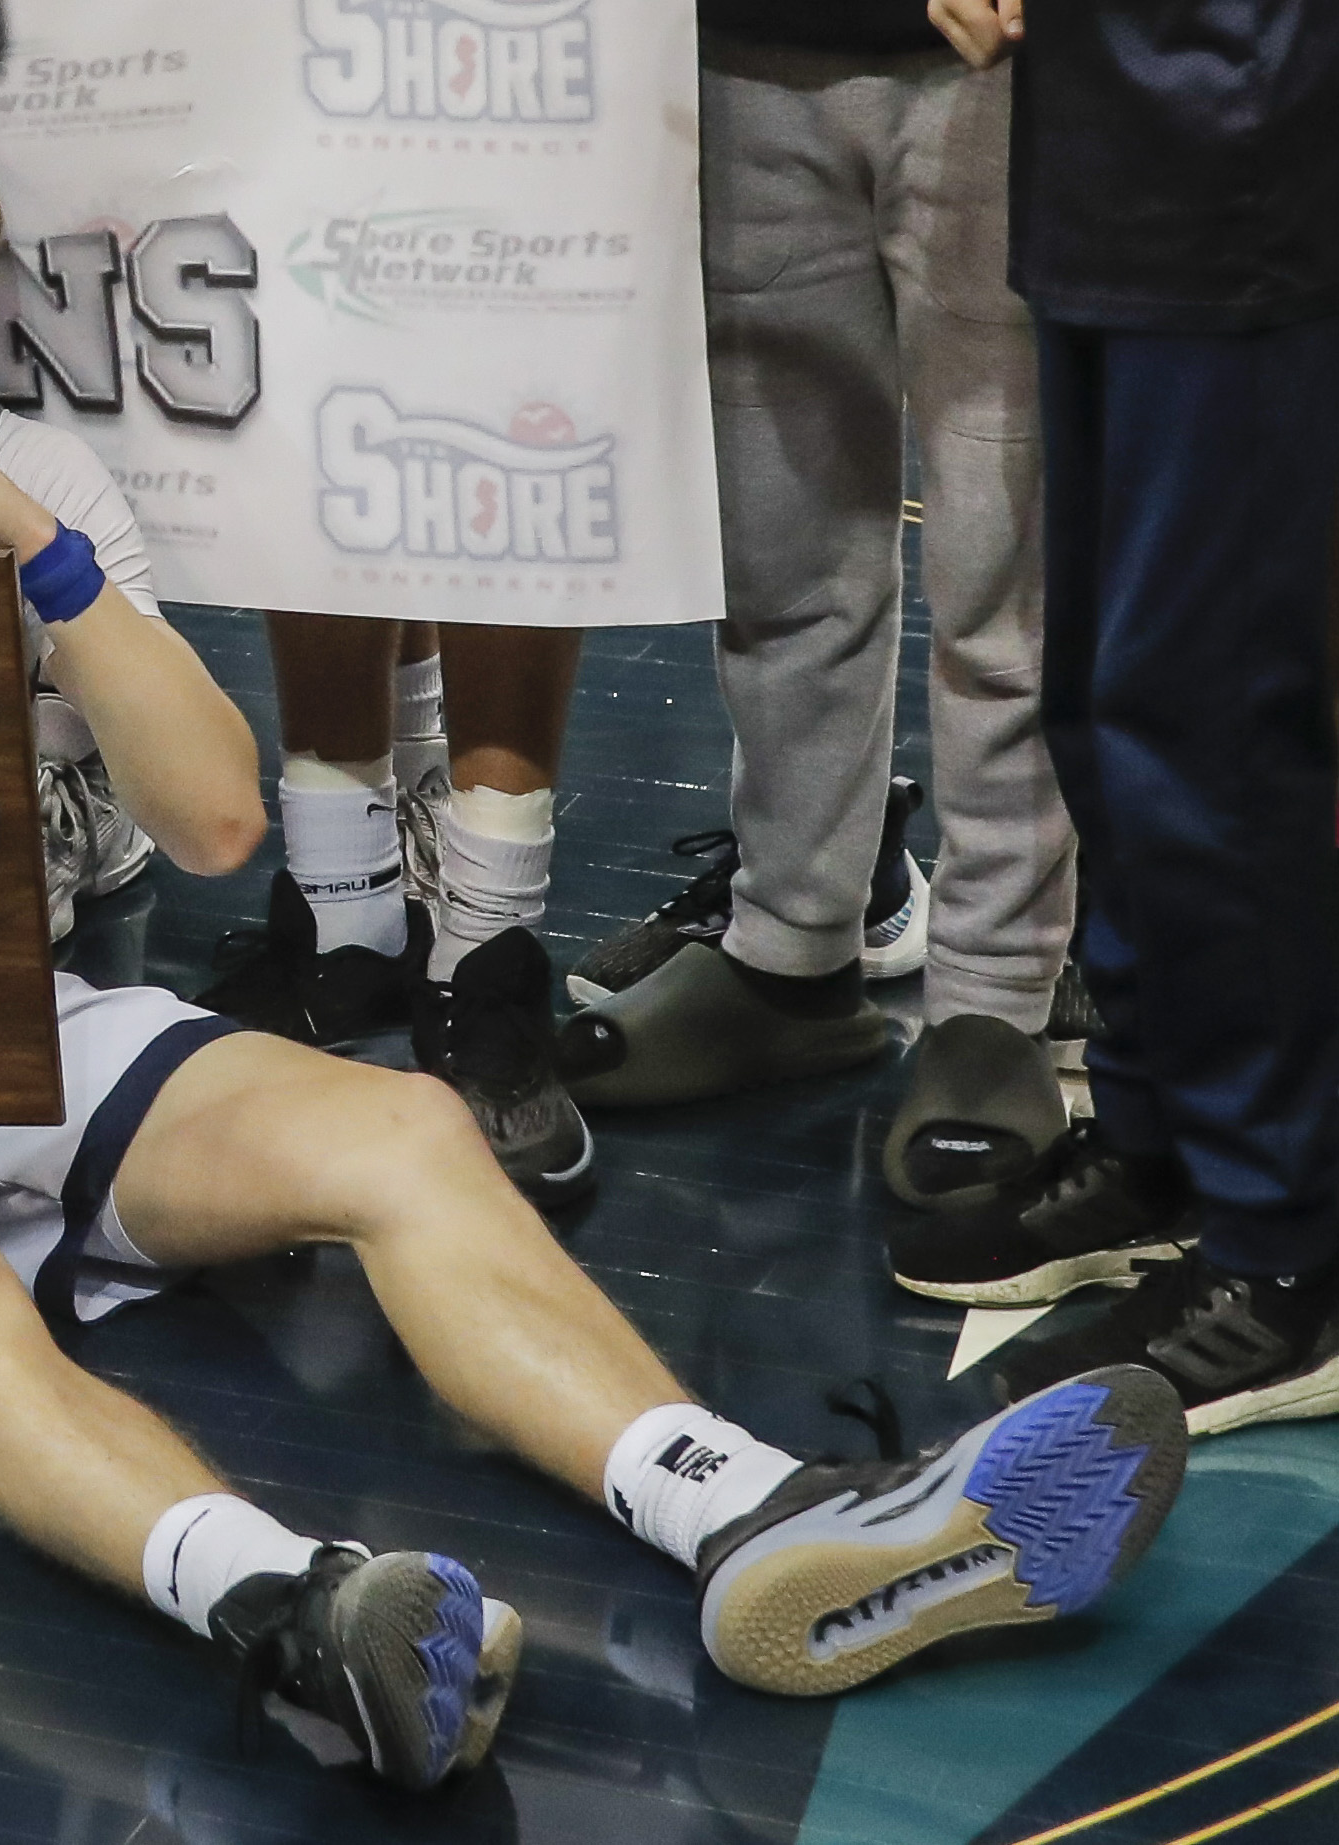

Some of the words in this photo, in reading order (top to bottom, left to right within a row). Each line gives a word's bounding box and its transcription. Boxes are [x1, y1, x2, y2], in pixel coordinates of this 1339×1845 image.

[26, 50, 190, 88] Sports
[318, 216, 457, 264] Shore
[471, 229, 632, 259] Sports
[358, 256, 538, 287] Network
[107, 466, 217, 496] ports
[315, 385, 619, 563] SHORE
